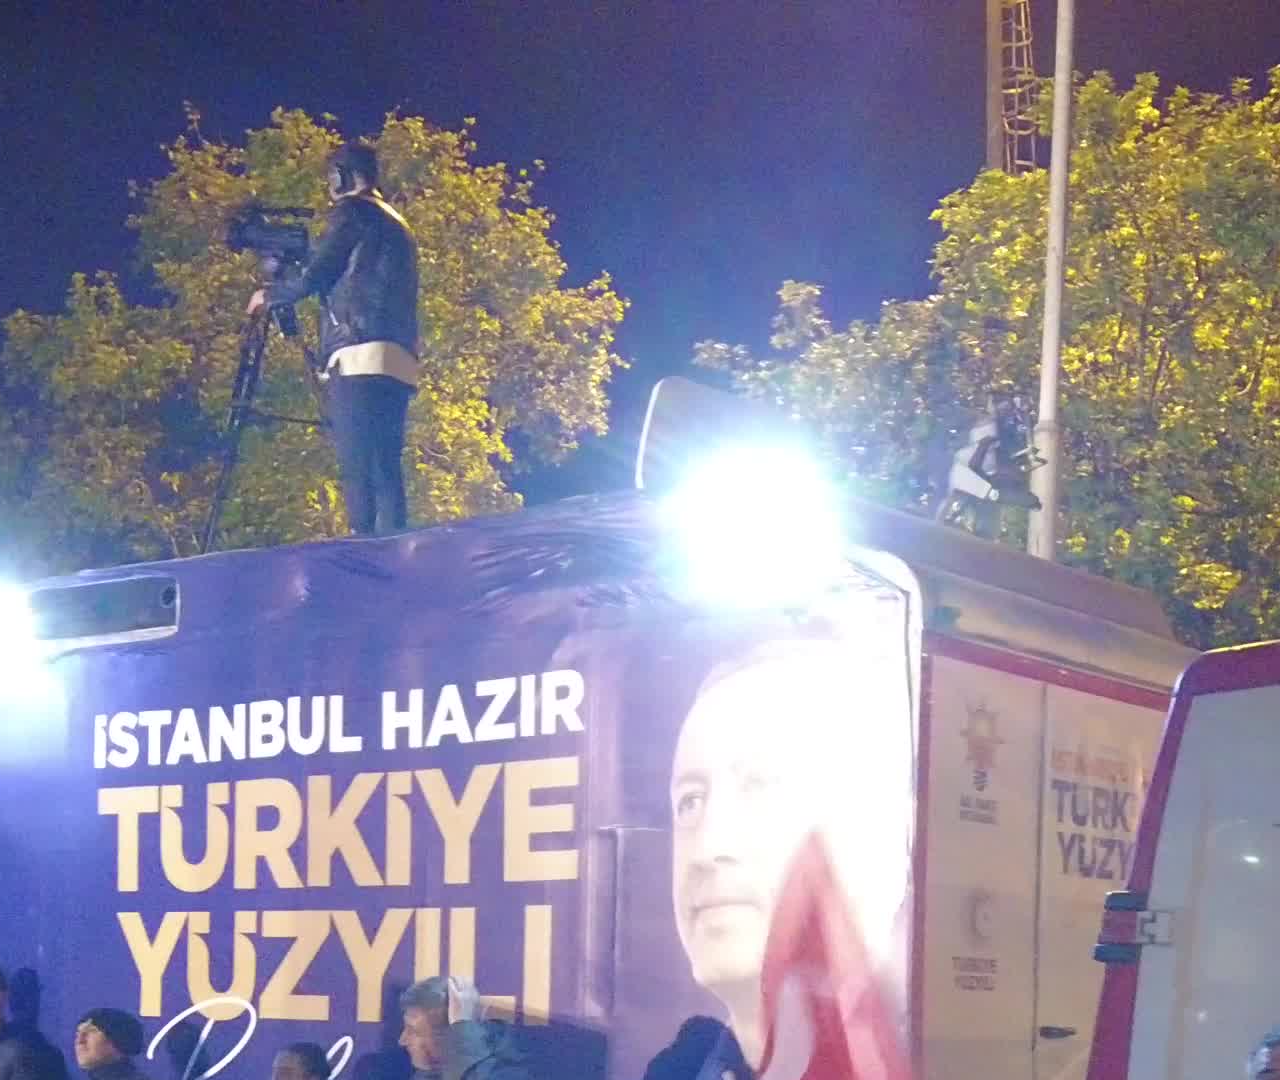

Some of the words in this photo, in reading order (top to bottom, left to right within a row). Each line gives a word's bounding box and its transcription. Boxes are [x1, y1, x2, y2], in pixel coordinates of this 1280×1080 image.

[93, 694, 362, 769] İSTANBUL
[381, 669, 585, 750] HAZIR
[97, 756, 580, 893] TÜRKİYE
[1051, 778, 1136, 833] TÜRK
[1056, 831, 1137, 881] YÜZY
[116, 904, 553, 1027] YÜZYILI
